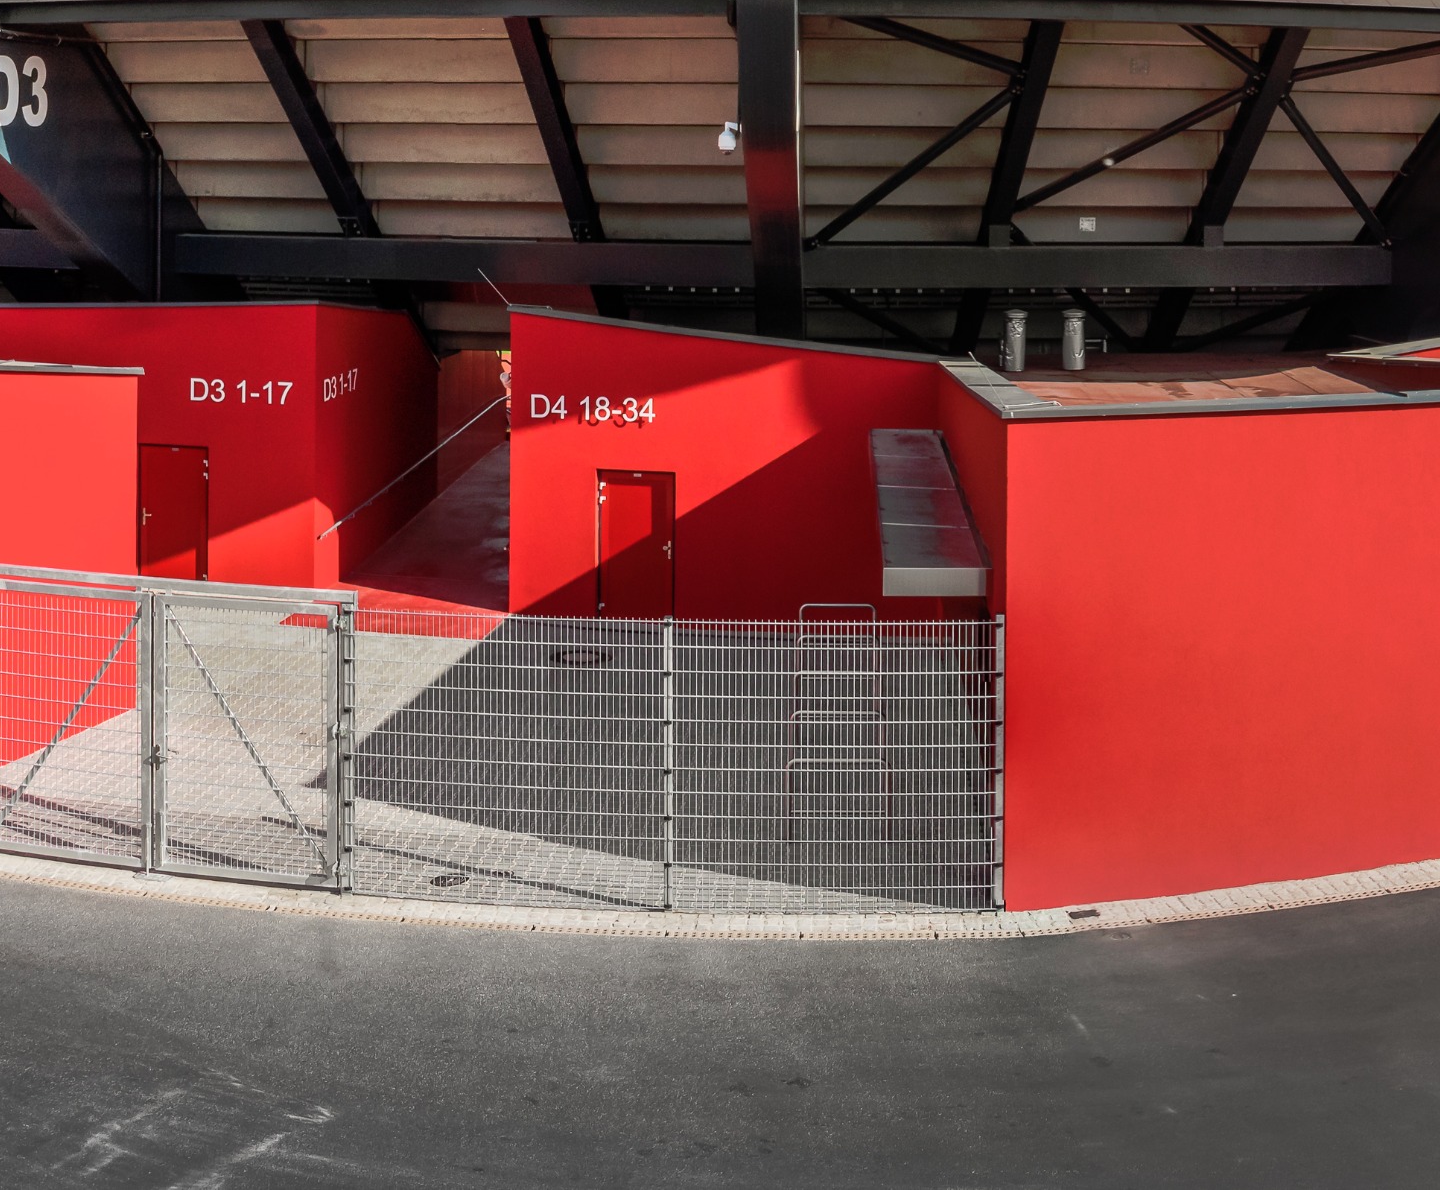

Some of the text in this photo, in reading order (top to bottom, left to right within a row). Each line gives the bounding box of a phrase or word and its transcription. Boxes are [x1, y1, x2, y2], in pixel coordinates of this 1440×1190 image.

[190, 377, 293, 405] D3 1-17
[323, 368, 358, 402] D3 1-17
[530, 394, 656, 423] D4 18-34
